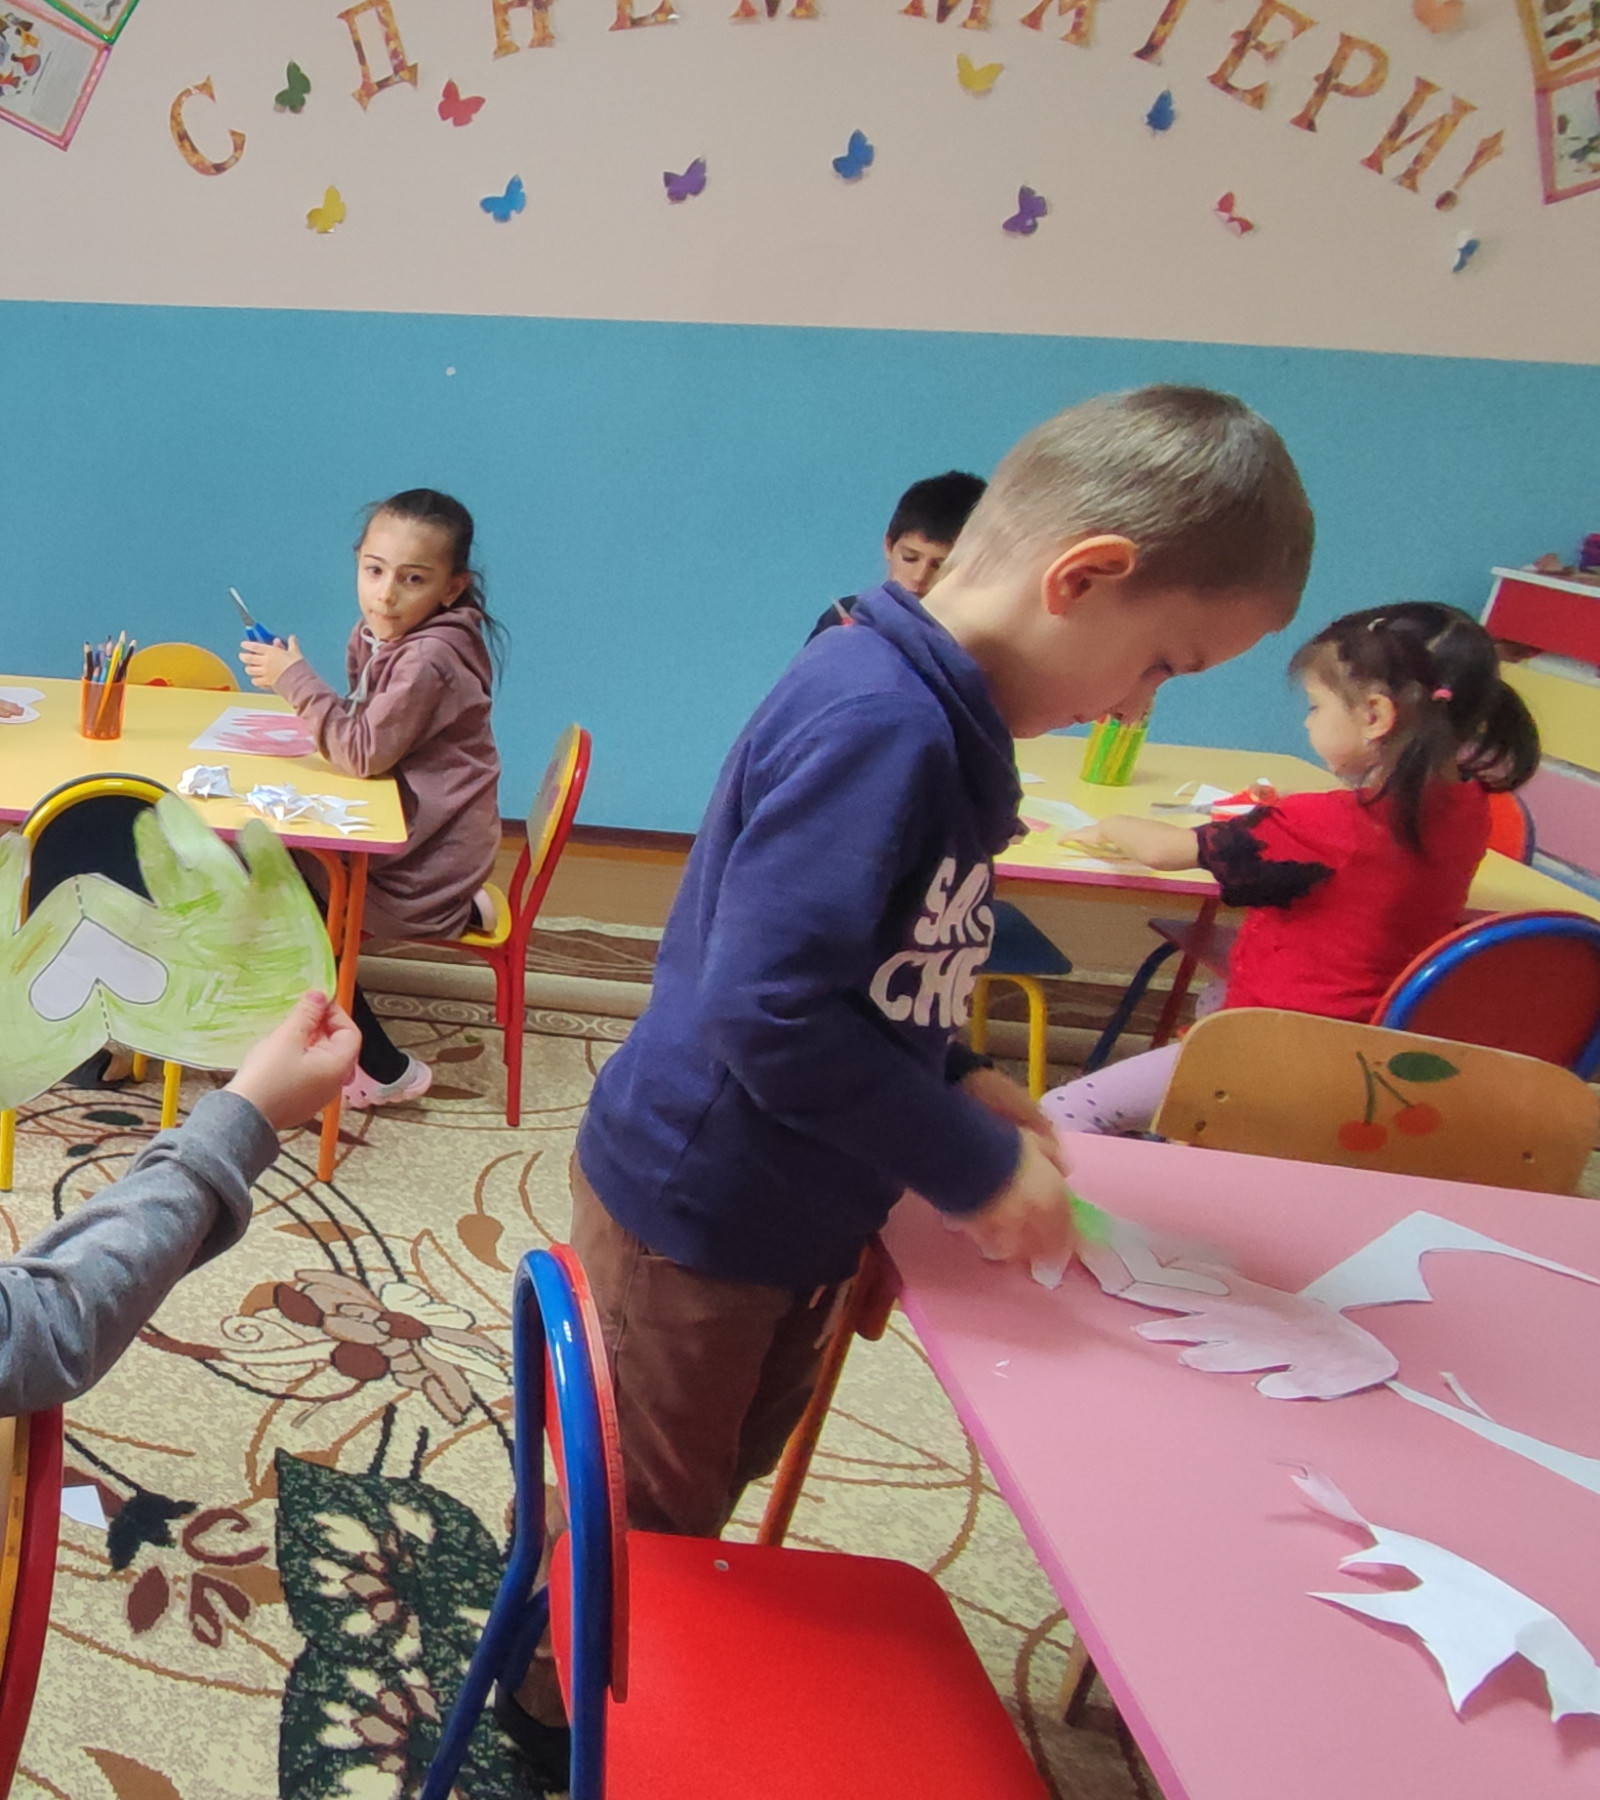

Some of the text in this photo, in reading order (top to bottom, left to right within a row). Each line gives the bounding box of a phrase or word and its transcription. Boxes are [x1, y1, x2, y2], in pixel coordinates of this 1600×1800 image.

[169, 0, 1505, 213] С ДН ЕРИ!
